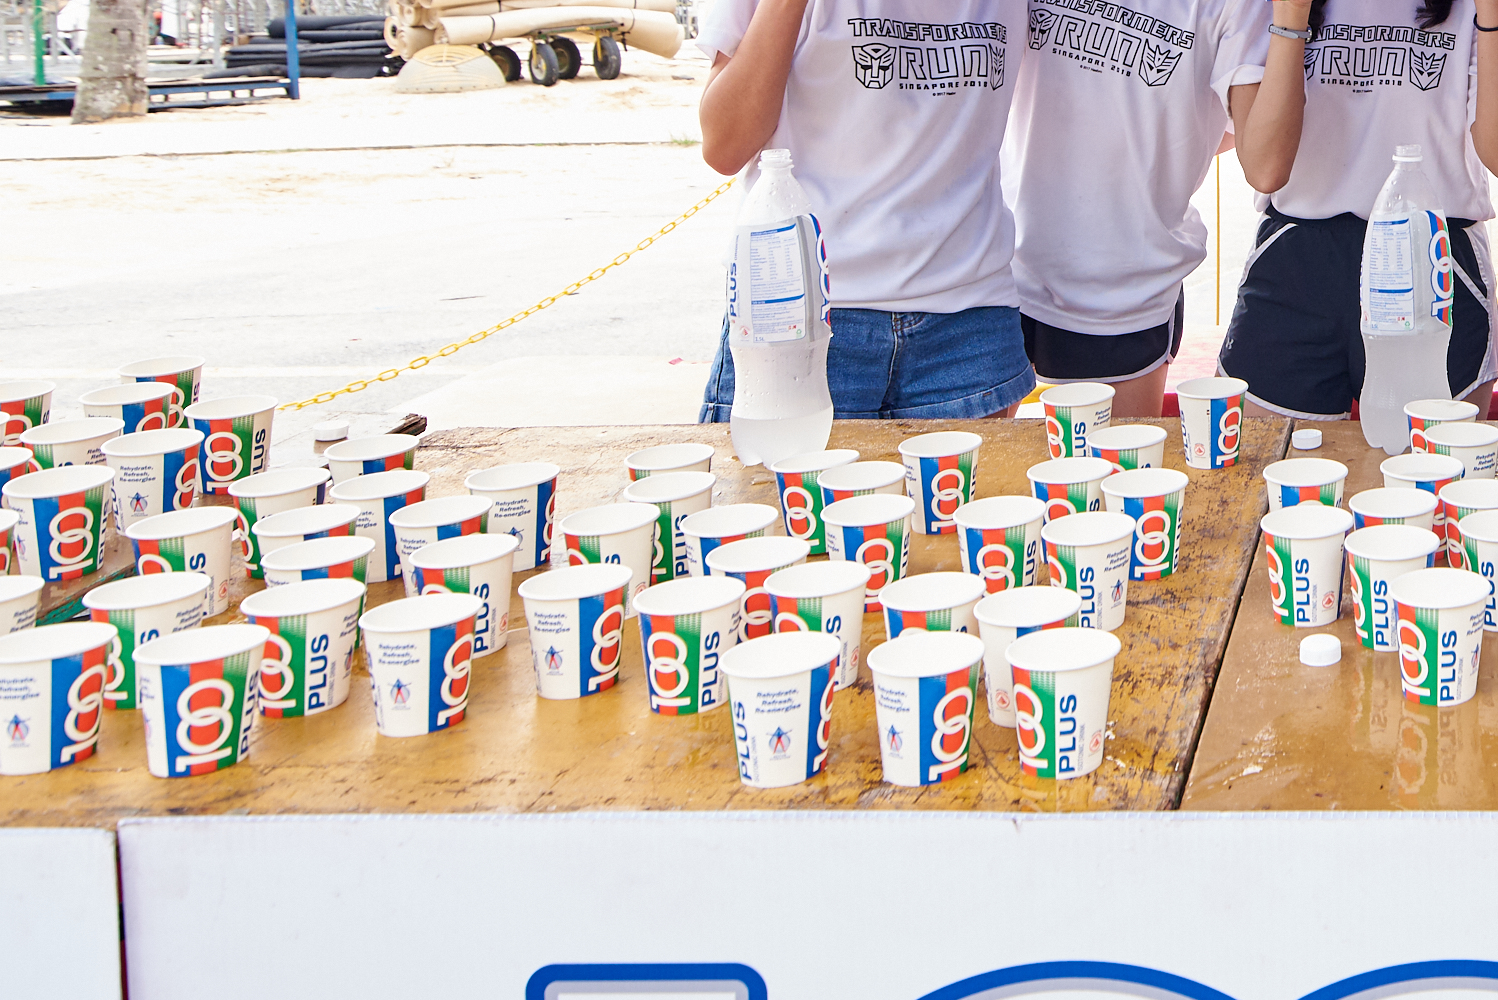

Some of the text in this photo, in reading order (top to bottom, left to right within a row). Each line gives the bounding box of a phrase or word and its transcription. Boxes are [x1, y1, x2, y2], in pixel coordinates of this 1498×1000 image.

[899, 45, 988, 80] RUN
[1052, 48, 1105, 67] SINGAPORE
[1054, 14, 1142, 67] RUN
[1314, 24, 1456, 50] NSFORMERS
[1321, 46, 1406, 77] RUN
[899, 82, 960, 90] SINGAPORE
[1321, 78, 1374, 86] SINGAPORE
[1429, 229, 1453, 317] 100
[204, 432, 244, 492] 100
[253, 428, 266, 475] LUS
[1075, 421, 1087, 459] LUS
[1216, 406, 1242, 466] 100
[931, 469, 965, 532] 100
[49, 507, 94, 580] 100
[1025, 539, 1037, 587] LUS
[1134, 510, 1171, 581] 100
[474, 583, 490, 654] PLUS
[1080, 566, 1095, 628] PLUS
[1295, 559, 1310, 623] PLUS
[1374, 579, 1390, 647] PLUS
[1481, 561, 1497, 627] PLUS
[258, 633, 297, 710] 100
[308, 634, 329, 710] PLUS
[437, 633, 475, 727] 100
[588, 604, 625, 692] 100
[647, 631, 691, 711] 100
[701, 631, 720, 707] PLUS
[1397, 619, 1431, 697] 100
[1440, 630, 1458, 702] PLUS
[60, 664, 107, 763] 100
[175, 678, 234, 773] 100
[735, 701, 752, 781] PLUS
[929, 687, 973, 781] 100
[1015, 683, 1048, 769] 100
[1059, 694, 1077, 773] PLUS
